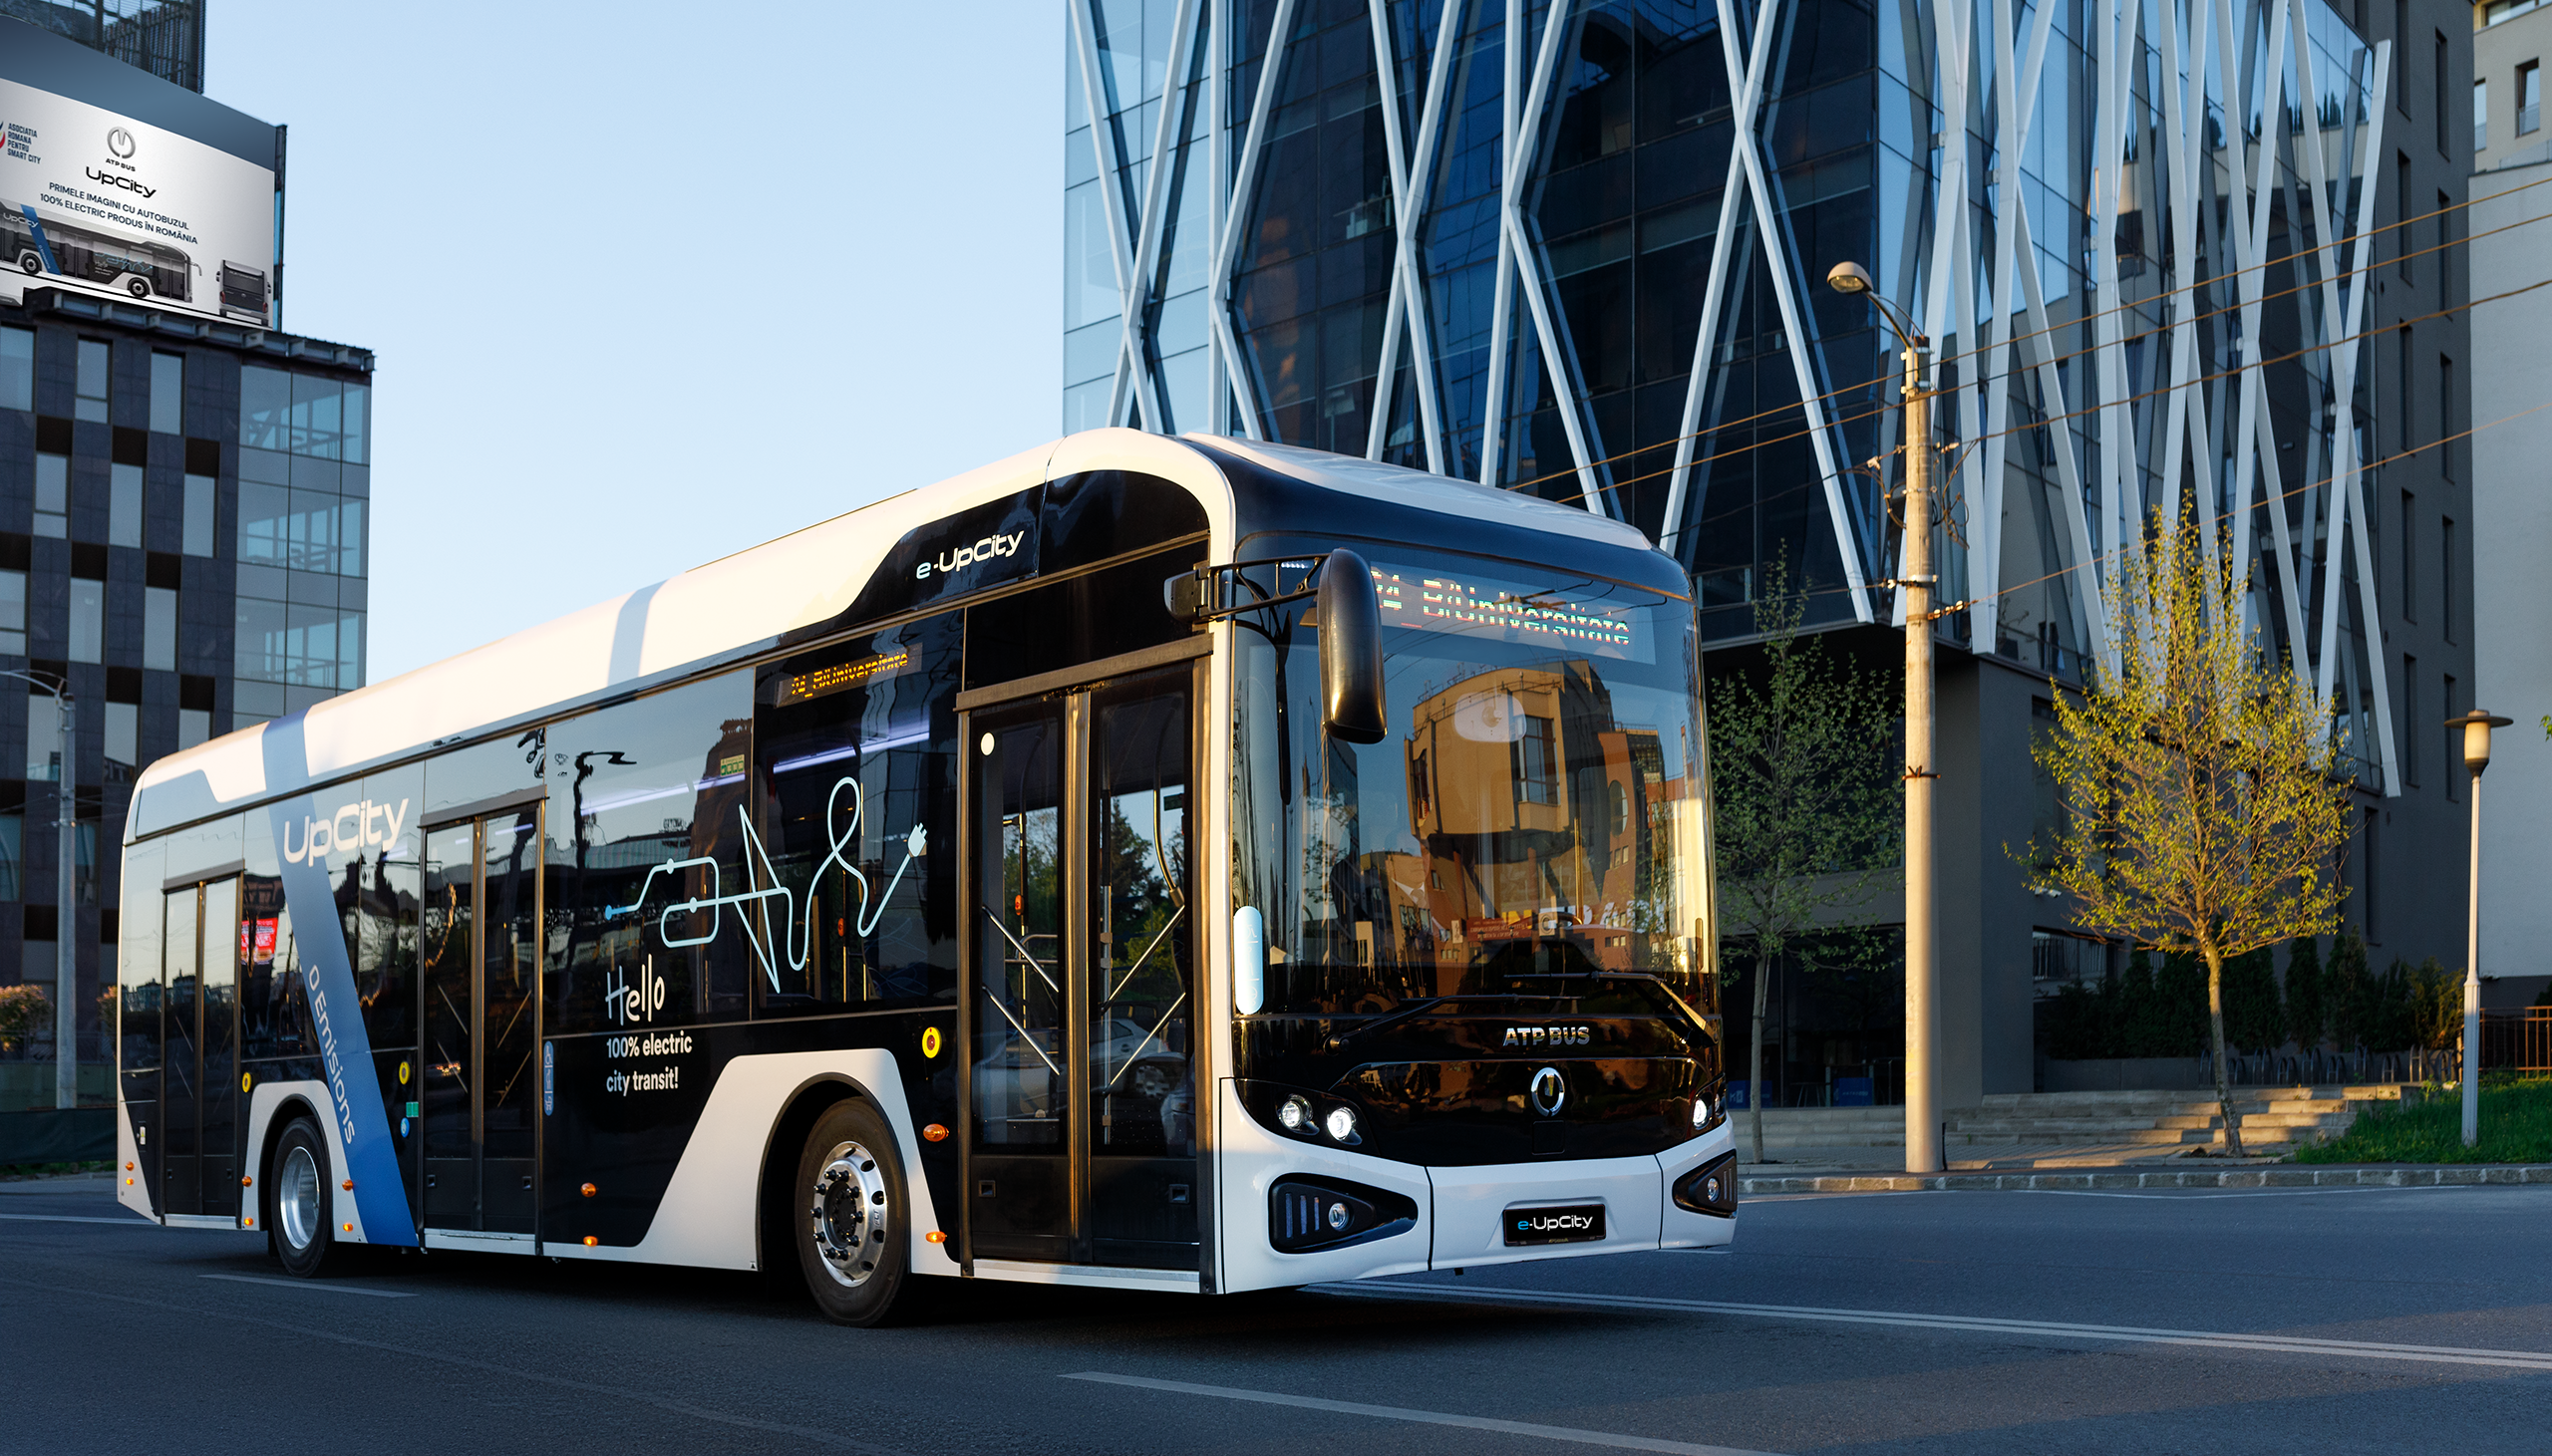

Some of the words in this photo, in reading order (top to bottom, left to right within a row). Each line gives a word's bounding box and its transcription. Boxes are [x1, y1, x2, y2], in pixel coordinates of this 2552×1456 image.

[8, 123, 38, 139] ASOCIATIA
[8, 131, 32, 146] ROMANA
[8, 140, 29, 152] PENTRU
[7, 148, 27, 160] SMART
[28, 154, 41, 164] CITY
[121, 162, 136, 172] BUS
[86, 165, 157, 198] UpCity
[40, 193, 64, 207] 100%
[65, 200, 106, 218] ELECTRIC
[107, 211, 144, 229] PRODUS
[145, 220, 155, 231] ÎN
[156, 226, 198, 244] ROMÂNIA
[49, 181, 85, 199] PRIMELE
[87, 192, 121, 210] IMAGINI
[123, 203, 136, 214] CU
[138, 208, 189, 230] AUTOBUZUL
[916, 530, 1024, 579] e-UpCity
[283, 798, 409, 867] UpCity
[605, 954, 665, 1025] Hello
[606, 1035, 640, 1058] 100%
[642, 1029, 693, 1056] electric
[1502, 1026, 1546, 1046] ATP
[1548, 1026, 1590, 1045] BUS
[314, 991, 356, 1144] Emisions
[606, 1069, 630, 1097] city
[632, 1066, 679, 1091] transit!
[1517, 1215, 1594, 1232] e-UpCity
